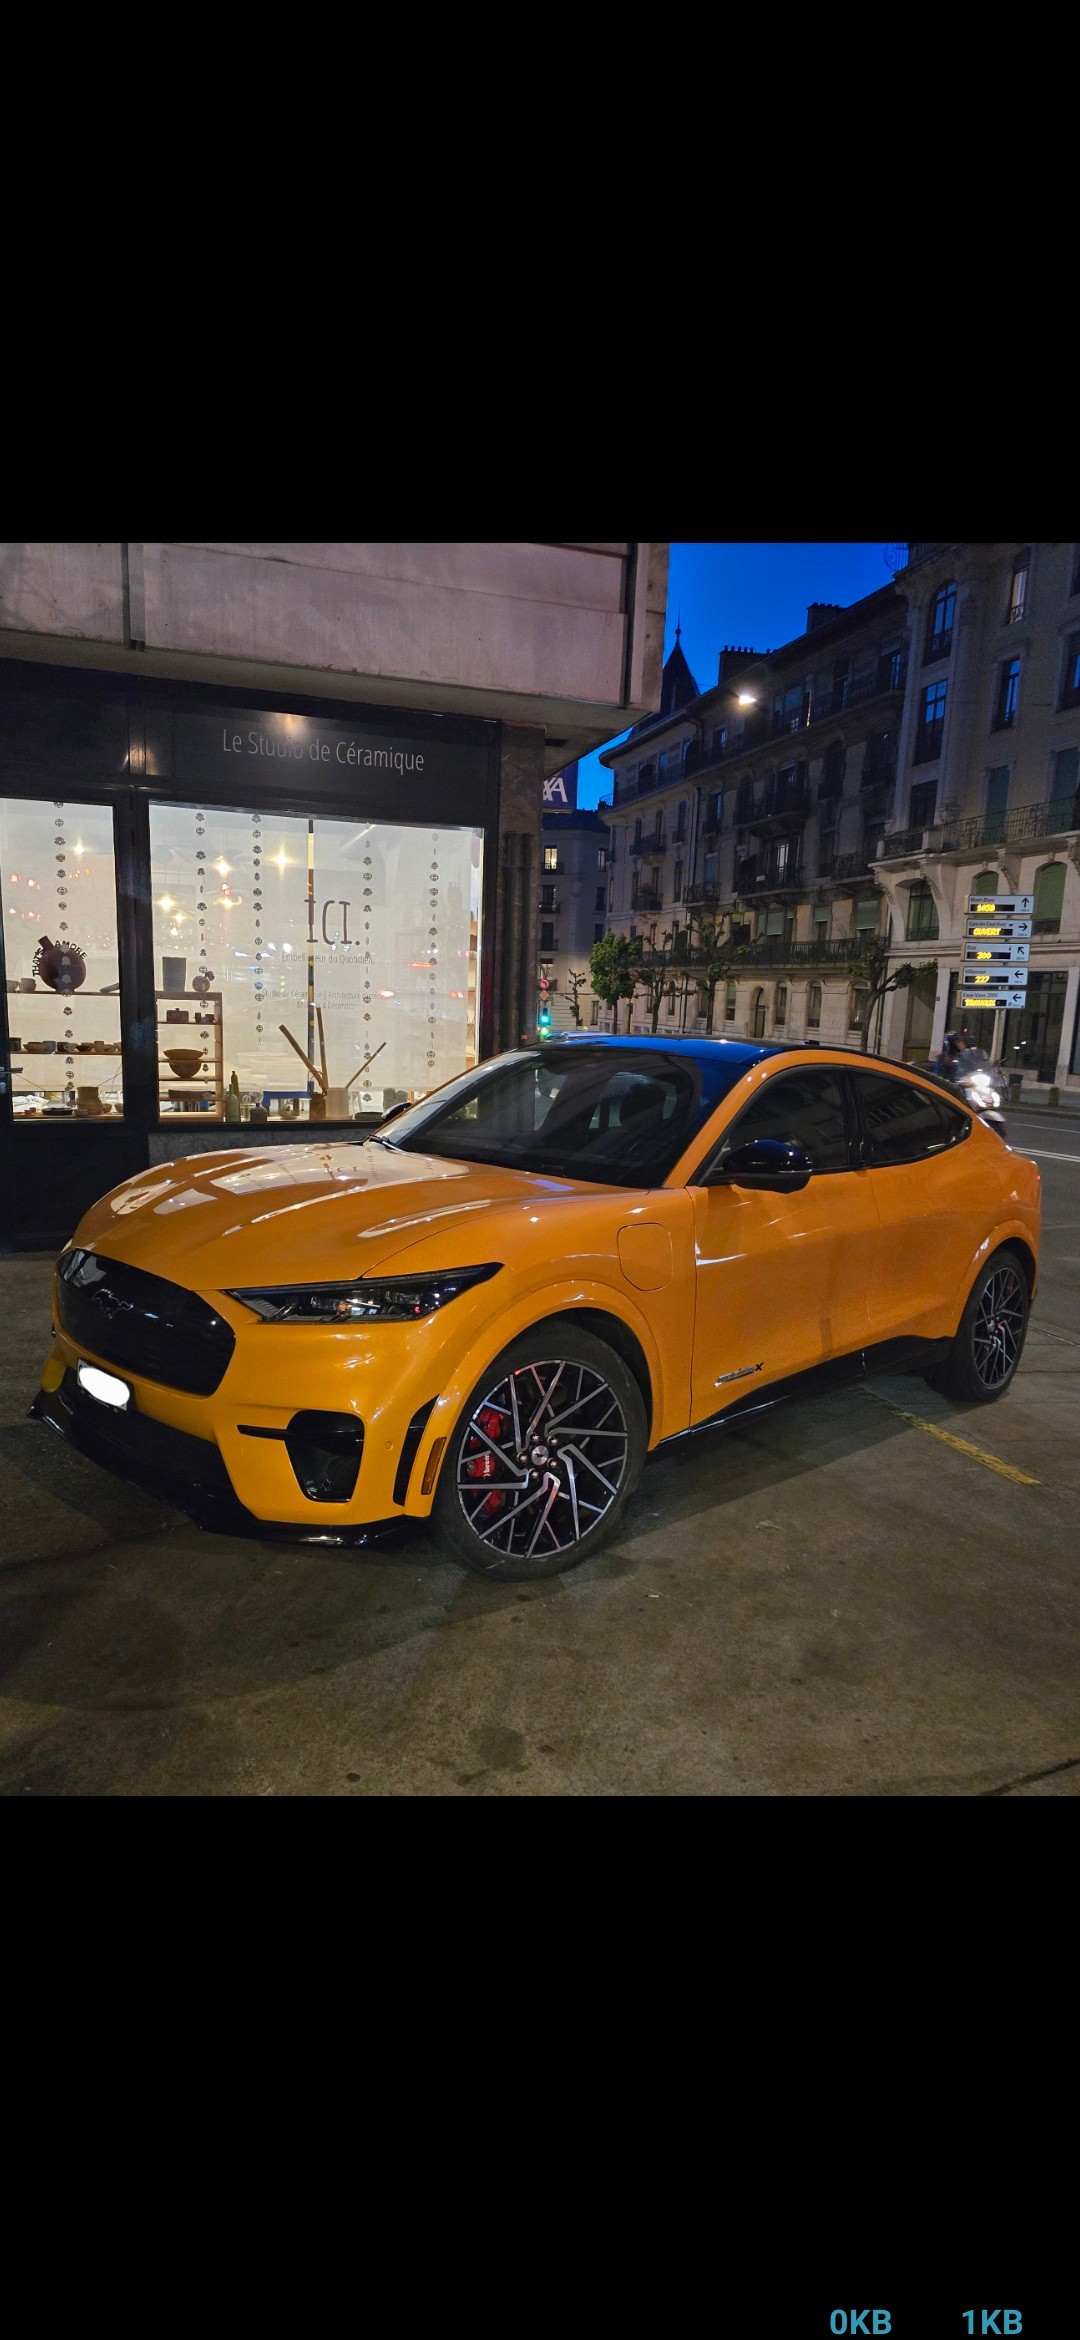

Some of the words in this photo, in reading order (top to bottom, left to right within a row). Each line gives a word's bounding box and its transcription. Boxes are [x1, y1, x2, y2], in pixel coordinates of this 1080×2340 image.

[222, 728, 242, 753] Le
[248, 731, 303, 760] Studio
[309, 739, 330, 762] de
[336, 741, 425, 775] Céramique
[542, 777, 568, 803] XA
[973, 927, 1001, 936] OUVERT
[54, 940, 88, 959] AMORE
[328, 953, 338, 963] du
